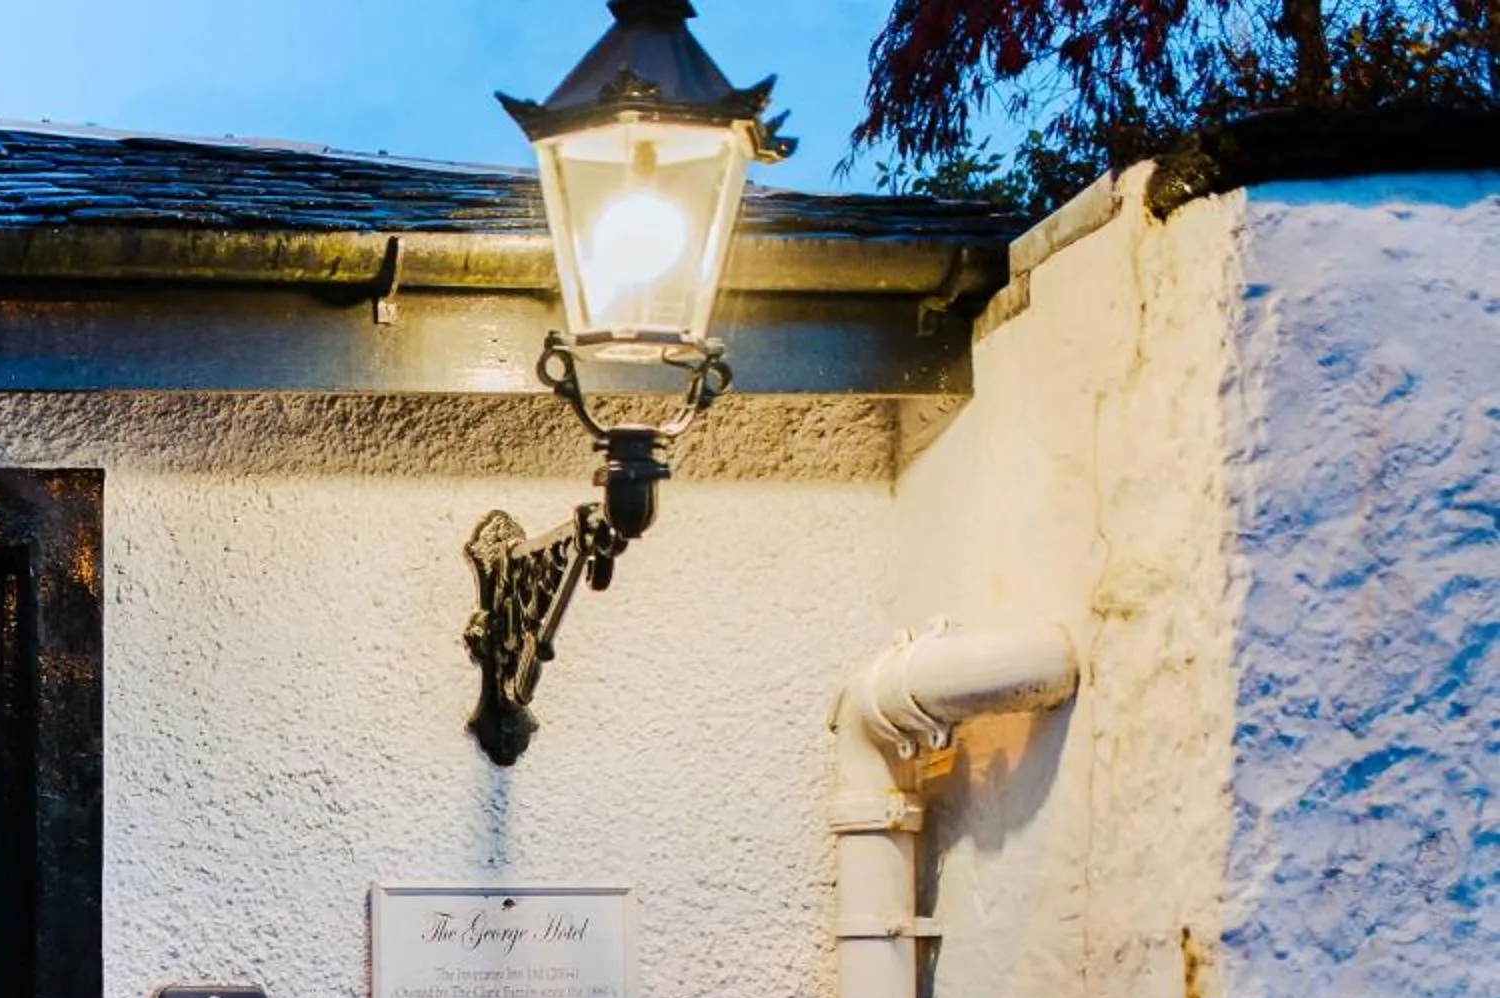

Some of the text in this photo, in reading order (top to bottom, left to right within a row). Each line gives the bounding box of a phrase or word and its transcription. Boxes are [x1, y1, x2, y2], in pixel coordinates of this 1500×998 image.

[421, 908, 589, 954] The George Hotel
